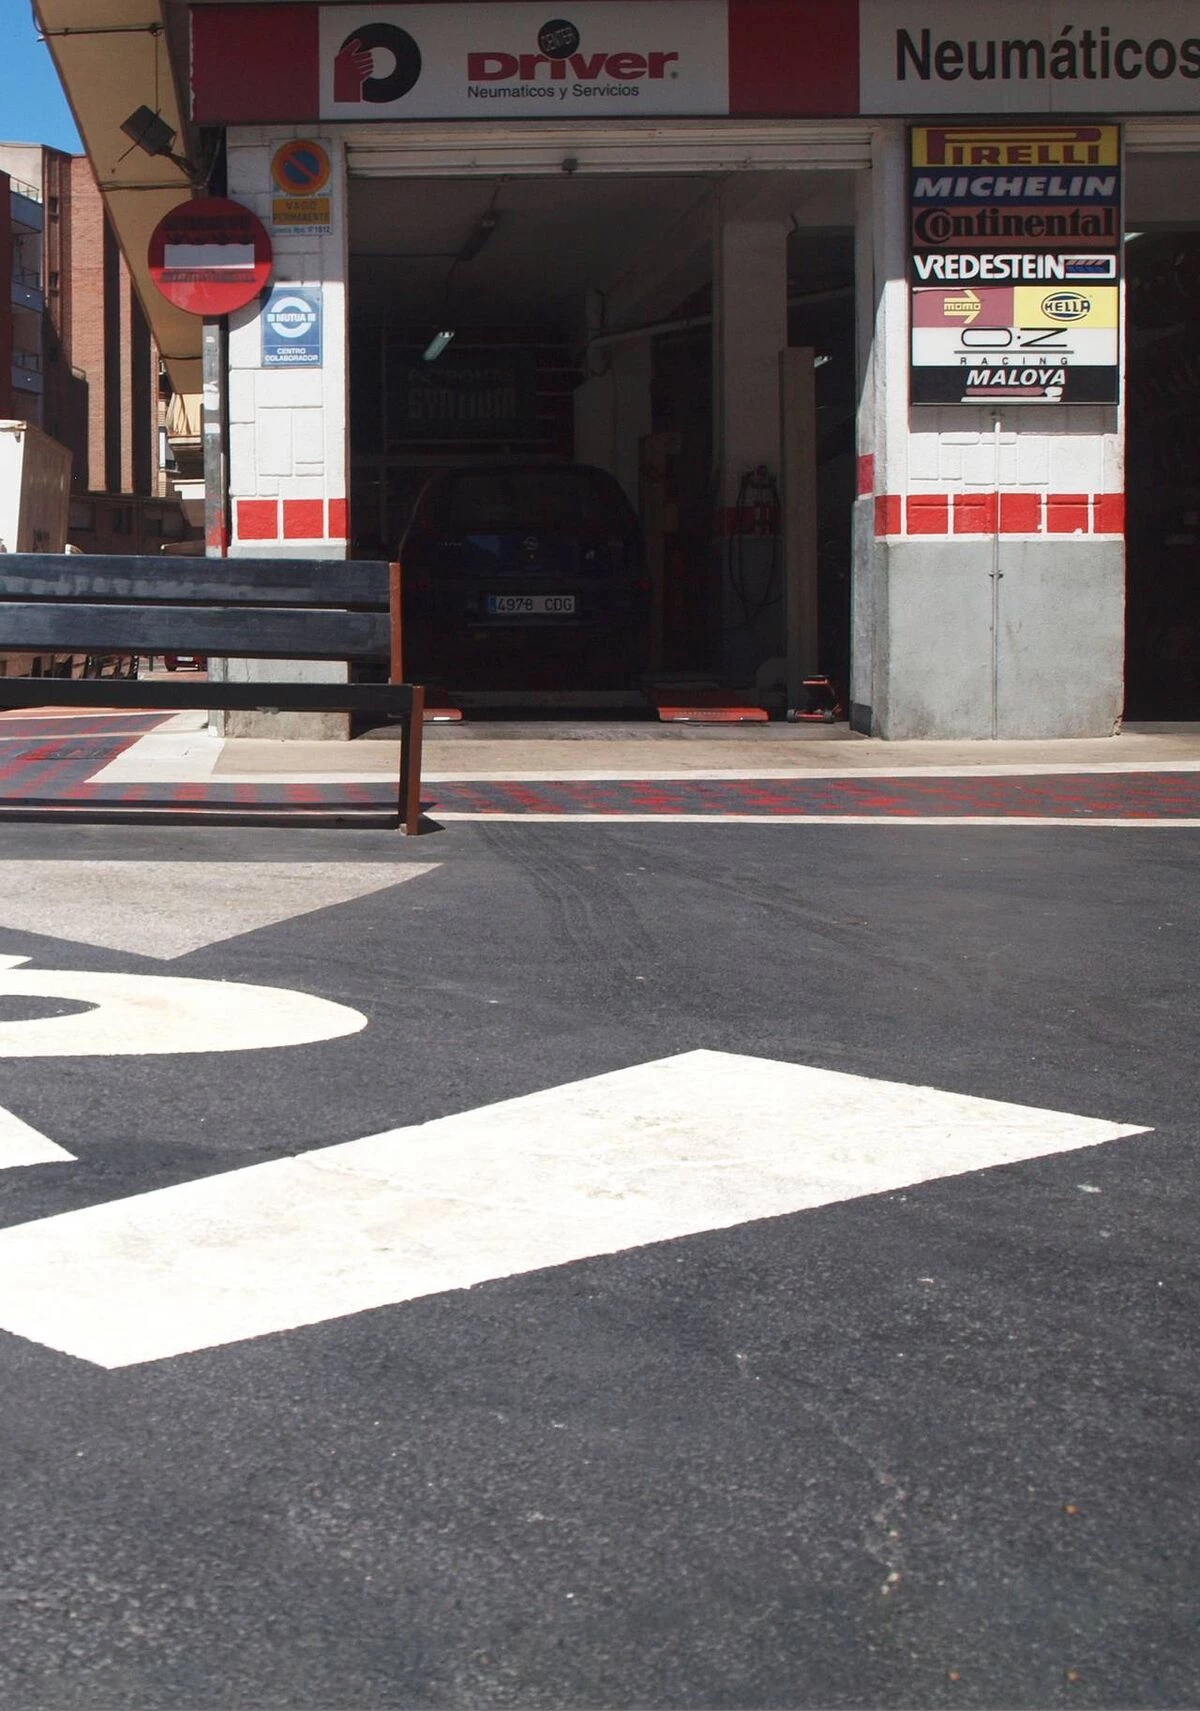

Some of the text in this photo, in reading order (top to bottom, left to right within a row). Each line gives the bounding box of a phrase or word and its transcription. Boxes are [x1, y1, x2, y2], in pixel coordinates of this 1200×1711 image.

[896, 25, 1200, 81] Neumáticos
[467, 51, 679, 81] Driver
[467, 83, 639, 100] Neumaticos y Servicios
[926, 128, 1102, 165] PIRELLI
[913, 176, 1116, 198] MICHELIN
[914, 207, 1115, 244] Continental
[913, 254, 1066, 280] VREDESTEIN
[277, 313, 306, 322] MUTUA
[960, 357, 1068, 366] RACING
[966, 369, 1066, 386] MALOYA
